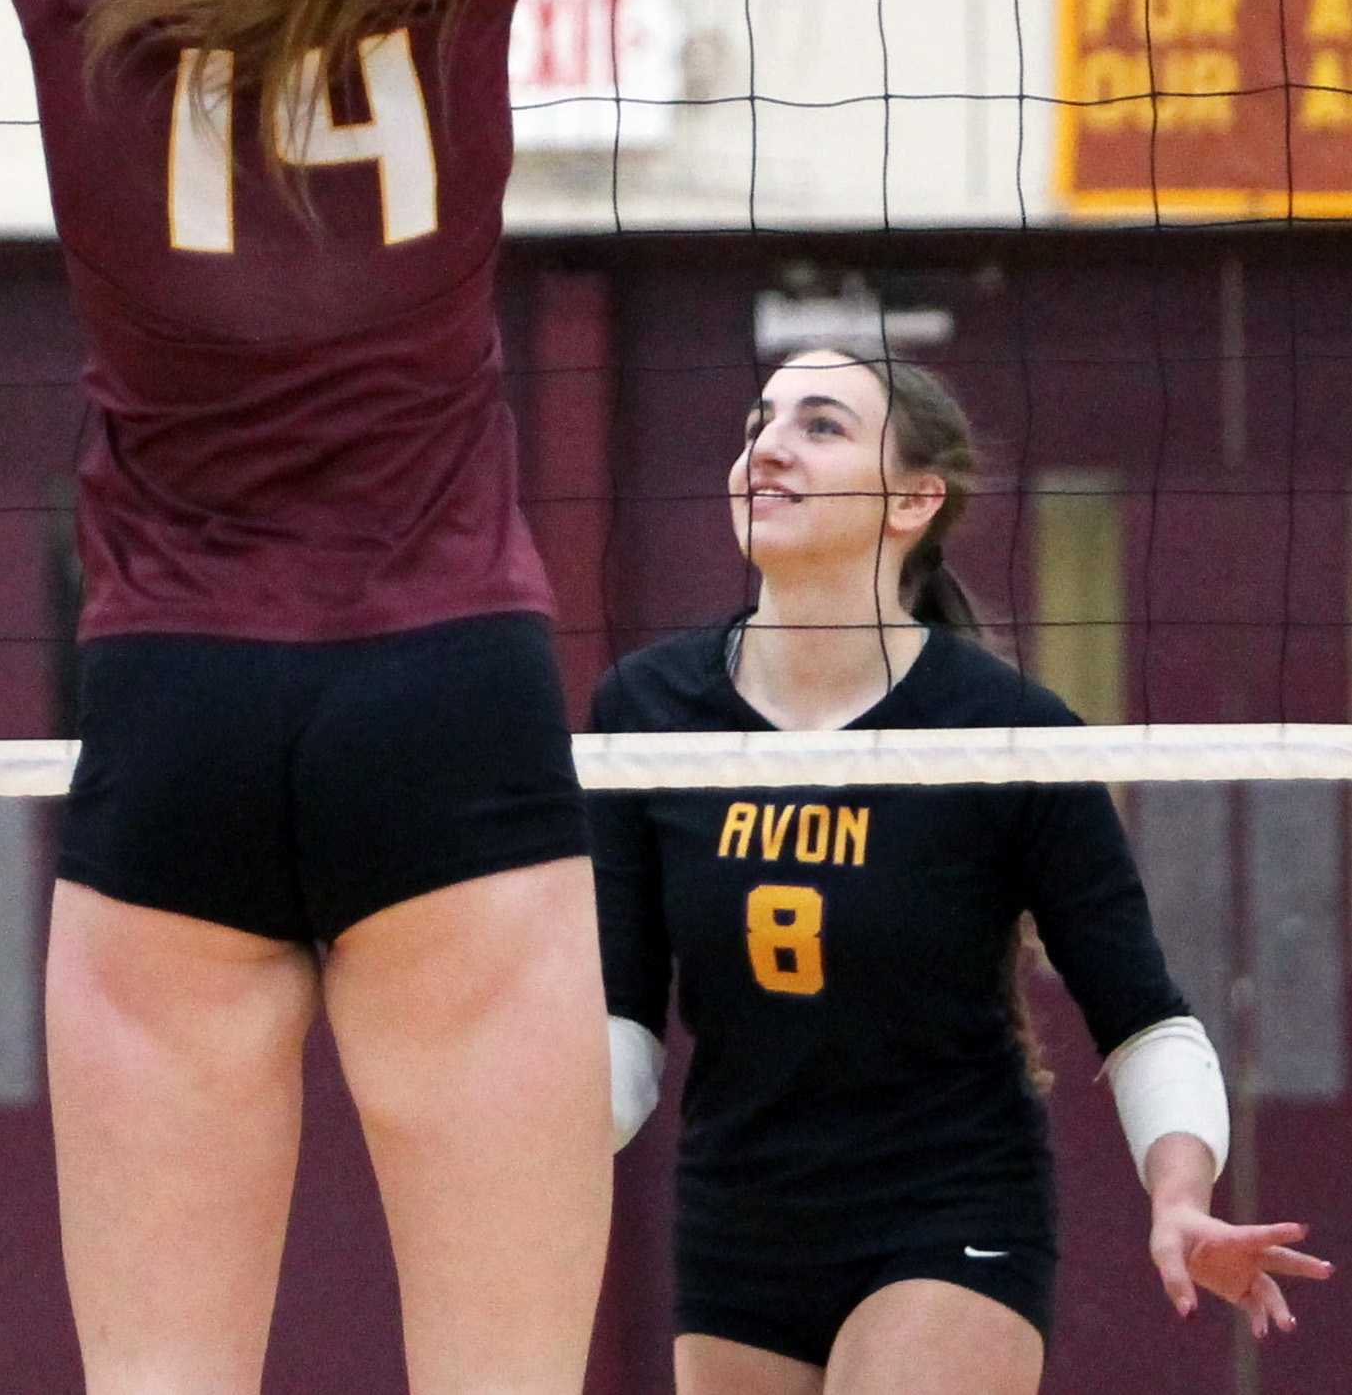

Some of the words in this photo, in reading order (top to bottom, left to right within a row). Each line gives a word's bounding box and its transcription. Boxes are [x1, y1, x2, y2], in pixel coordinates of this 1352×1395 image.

[168, 27, 438, 253] 14
[717, 802, 870, 866] AVON
[747, 884, 824, 995] 8
